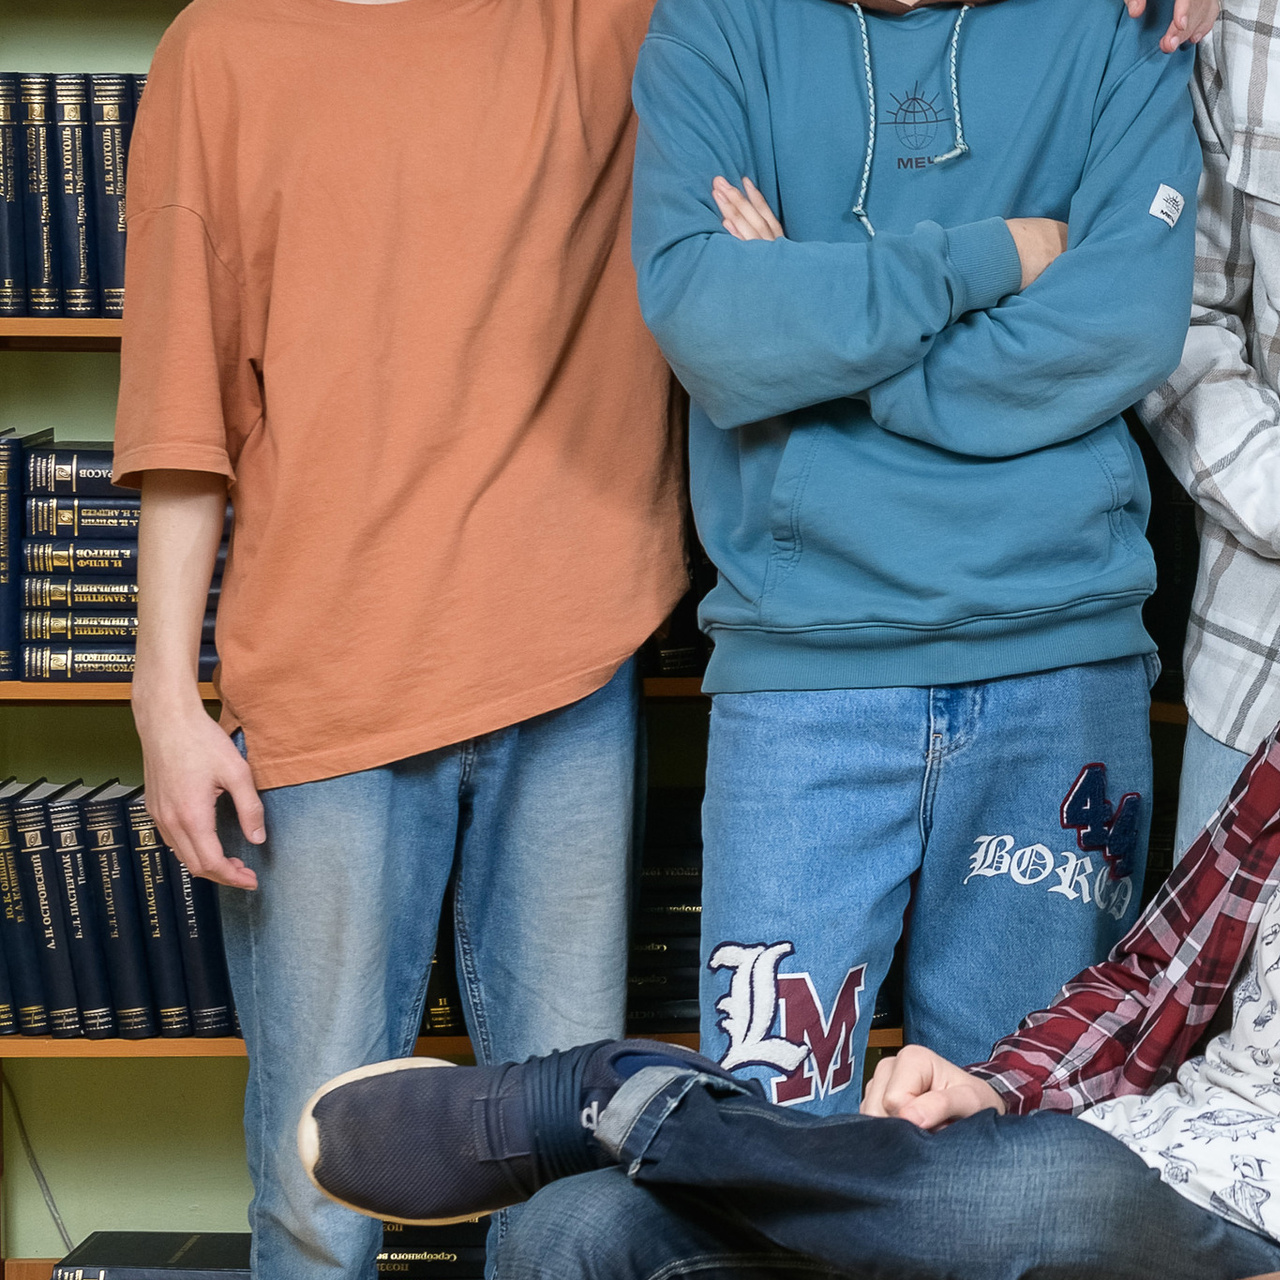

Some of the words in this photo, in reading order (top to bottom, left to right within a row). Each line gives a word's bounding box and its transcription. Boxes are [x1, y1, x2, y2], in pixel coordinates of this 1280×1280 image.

[62, 127, 73, 169] ГОГОЛЬ
[103, 128, 113, 170] ГОГОЛЬ
[75, 549, 119, 559] ПЕТРОВ
[76, 559, 109, 568] ИЛЬФ
[74, 593, 127, 603] ЗАМЯТИН
[30, 854, 52, 925] ОСТРОВСКИЙ
[62, 854, 80, 916] ПАСТЕРНАК
[140, 853, 157, 915] ПАСТЕРНАК
